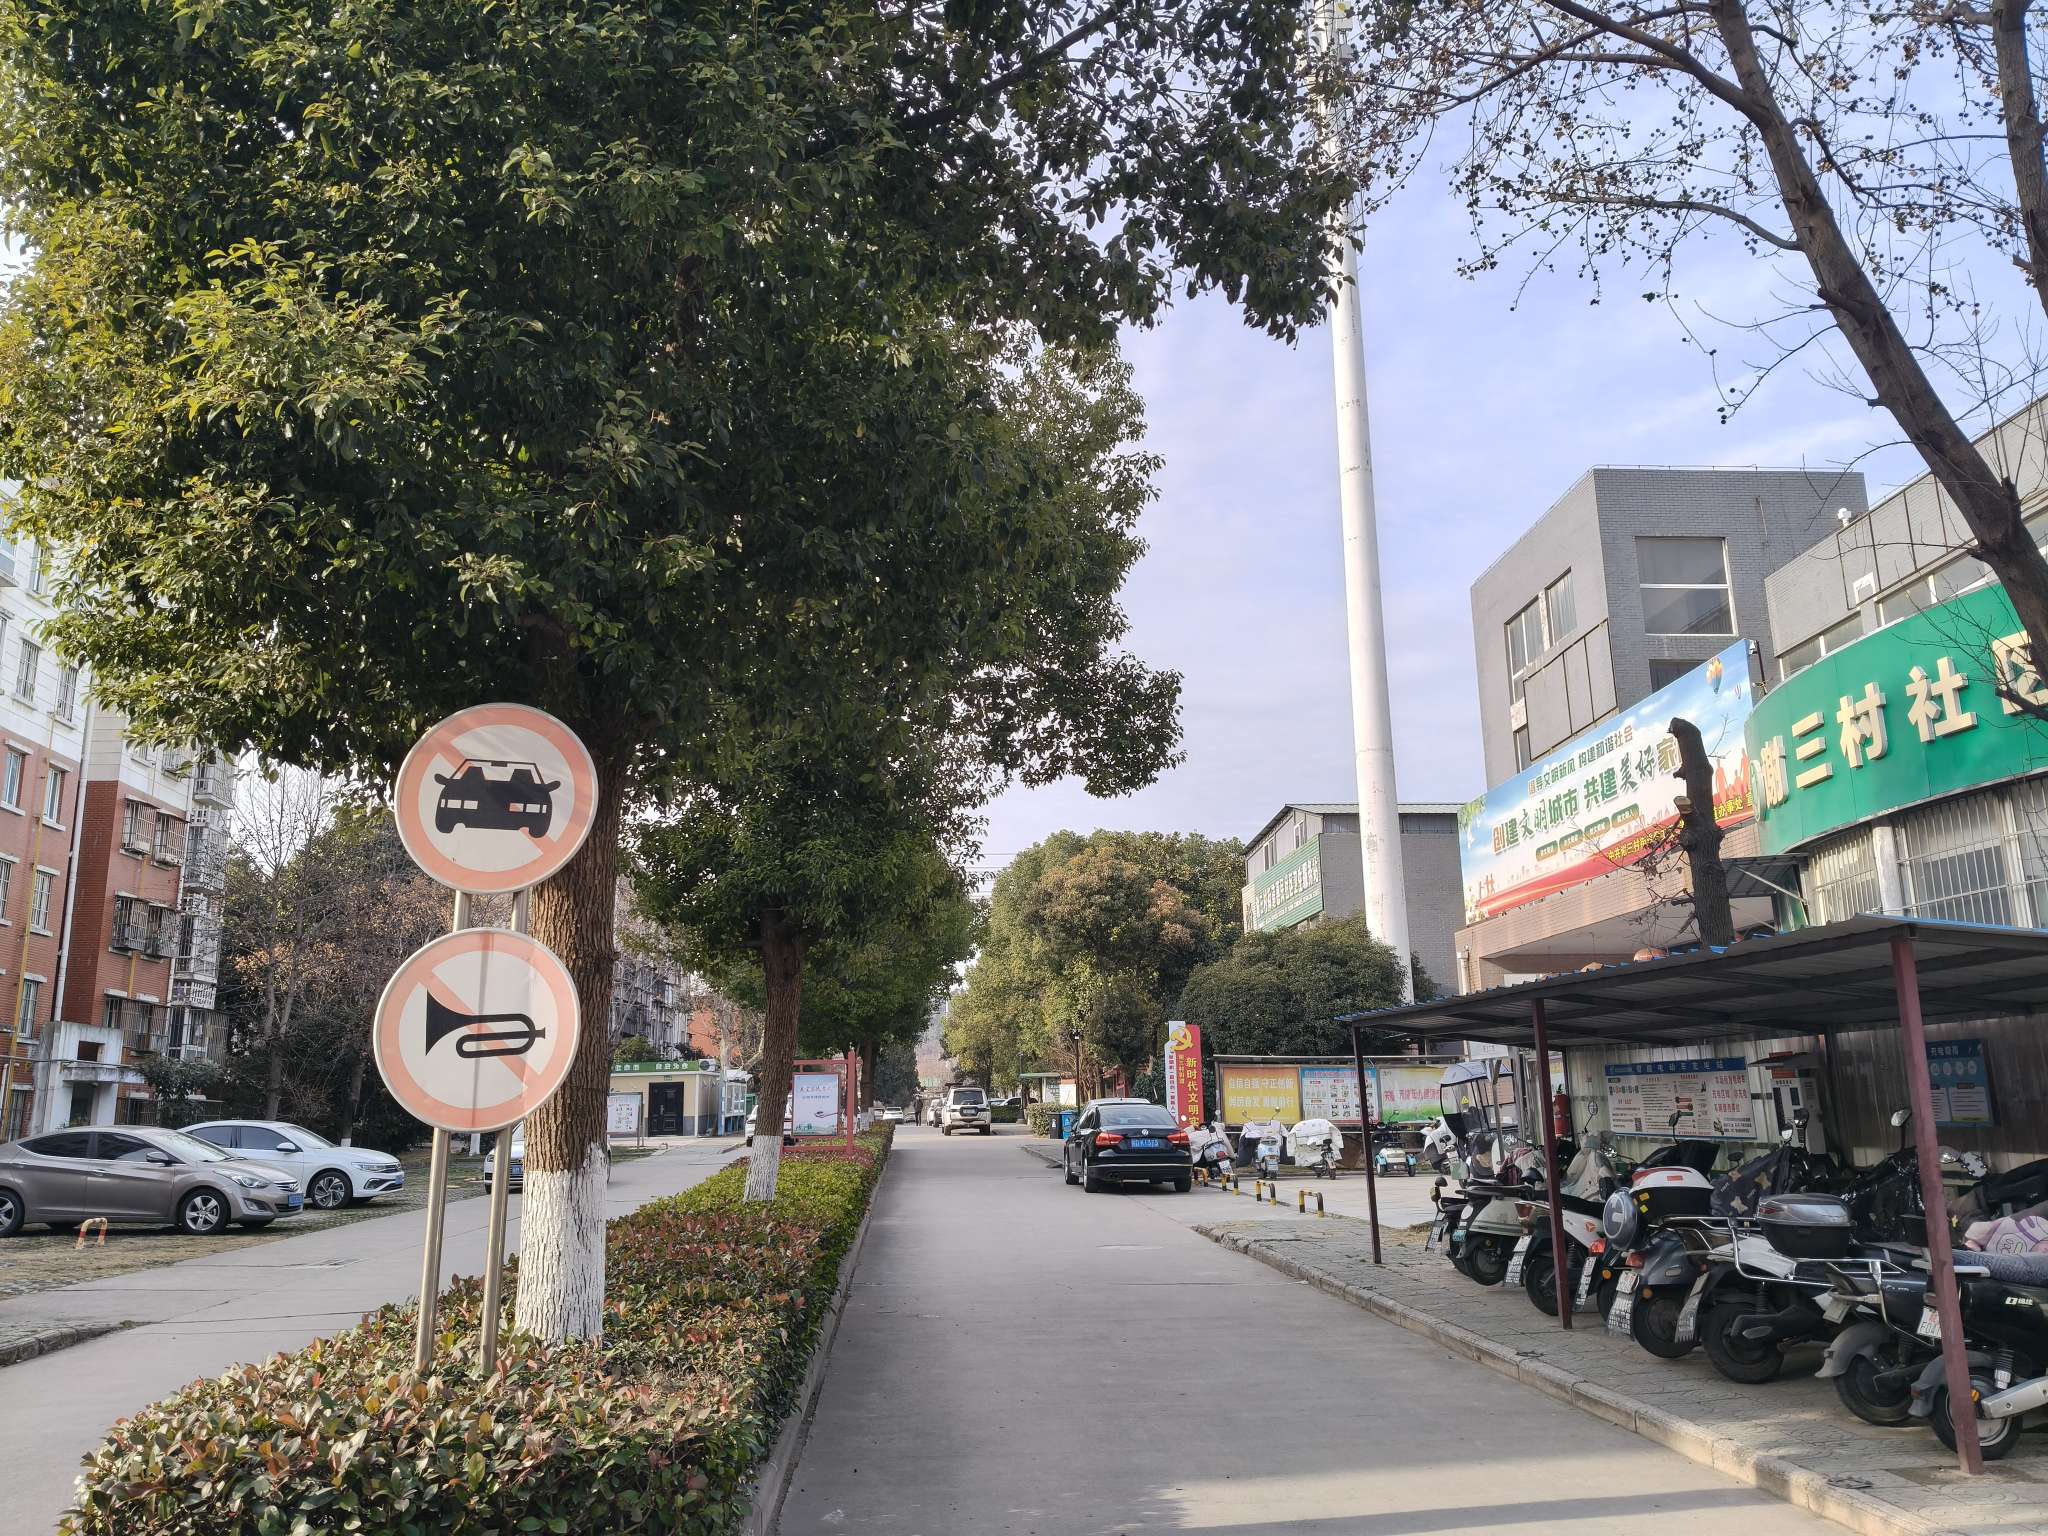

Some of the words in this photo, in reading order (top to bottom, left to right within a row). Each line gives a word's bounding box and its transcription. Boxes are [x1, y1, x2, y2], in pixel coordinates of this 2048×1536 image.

[1528, 757, 1576, 796] 倡导文明新风
[1578, 725, 1634, 769] 构建和谐社会
[1492, 786, 1579, 854] 创建文明城市
